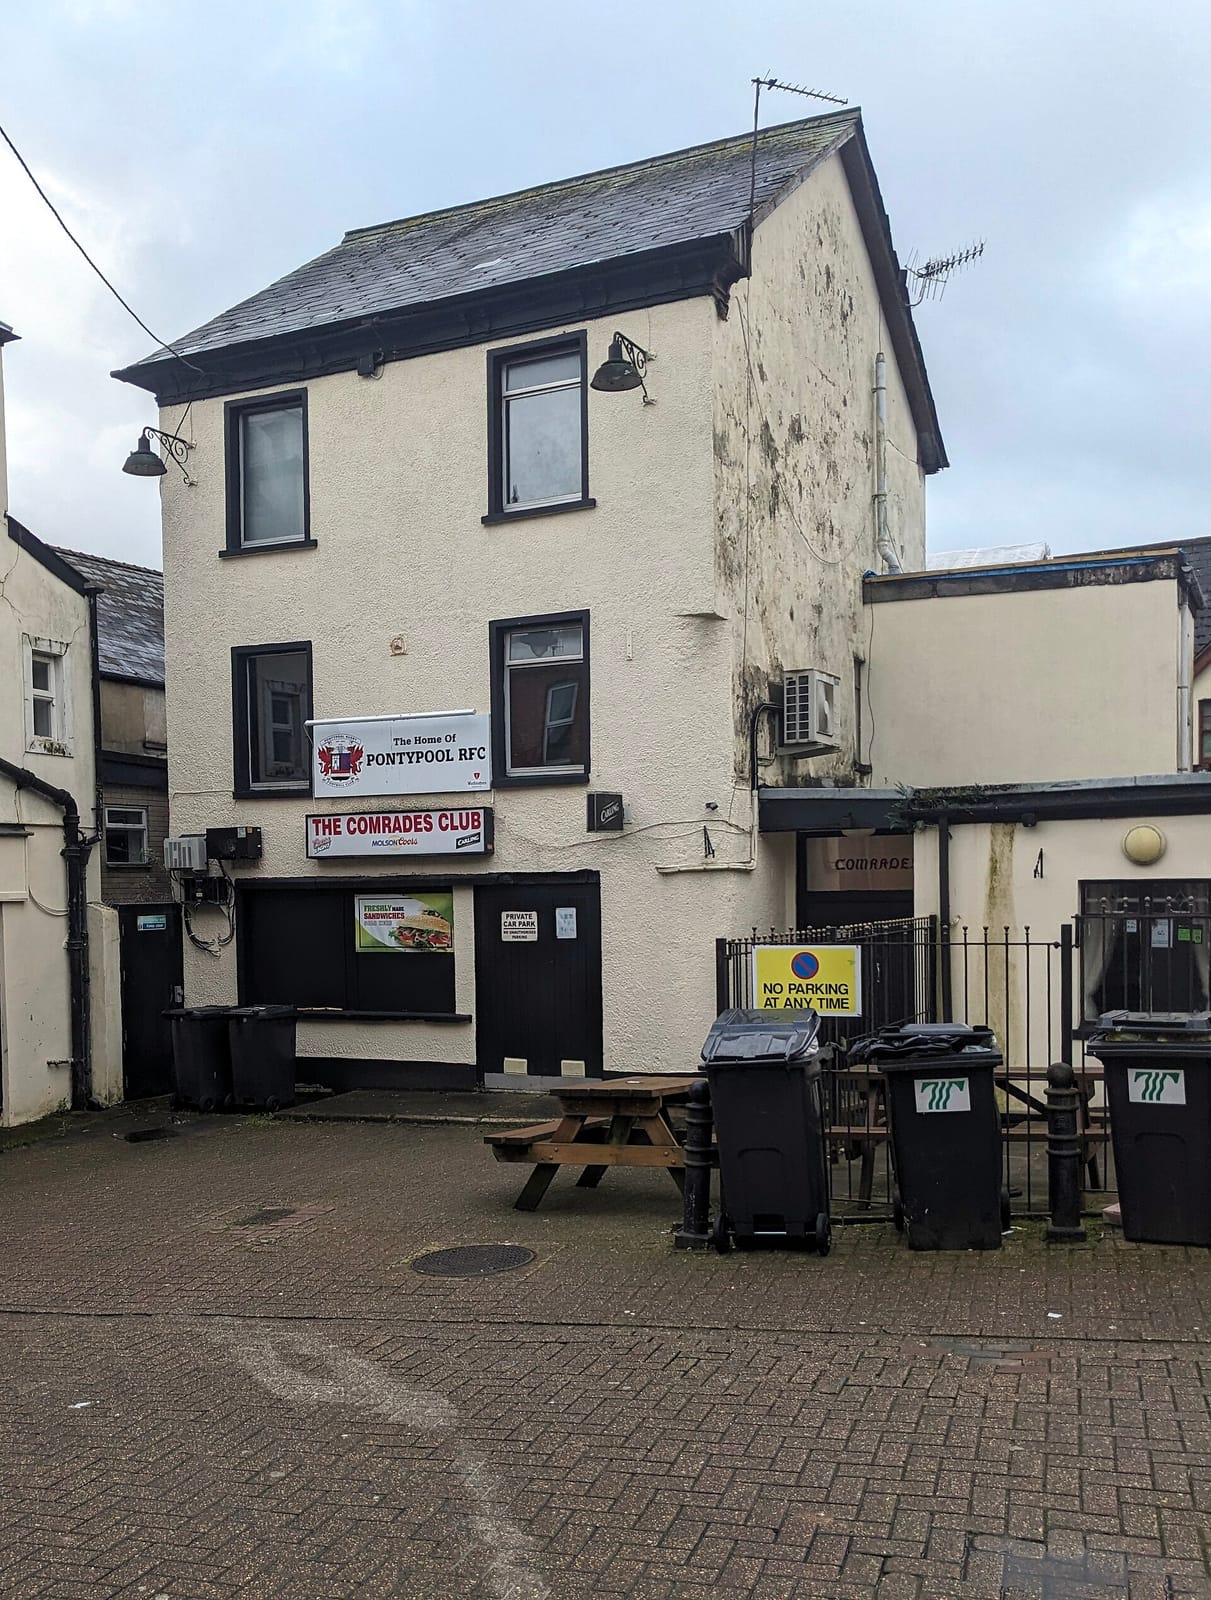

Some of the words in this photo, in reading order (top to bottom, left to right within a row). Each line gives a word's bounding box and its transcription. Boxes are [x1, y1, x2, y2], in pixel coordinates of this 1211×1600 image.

[393, 737, 411, 746] The
[414, 736, 441, 745] Home
[444, 734, 456, 744] Of
[366, 749, 454, 766] PONTYPOOL
[459, 747, 486, 761] RFC
[312, 817, 342, 836] THE
[346, 814, 433, 834] COMRADES
[438, 811, 481, 832] CLUB
[372, 839, 398, 847] MOLSON
[398, 837, 418, 846] Coors
[457, 834, 480, 846] CARLING
[835, 857, 914, 871] COMRADE
[364, 904, 392, 912] FRESHLY
[364, 912, 405, 920] SANDWICHES
[763, 983, 783, 995] NO
[788, 983, 849, 995] PARKING
[763, 998, 780, 1009] AT
[783, 998, 812, 1009] ANY
[816, 998, 850, 1009] TIME
